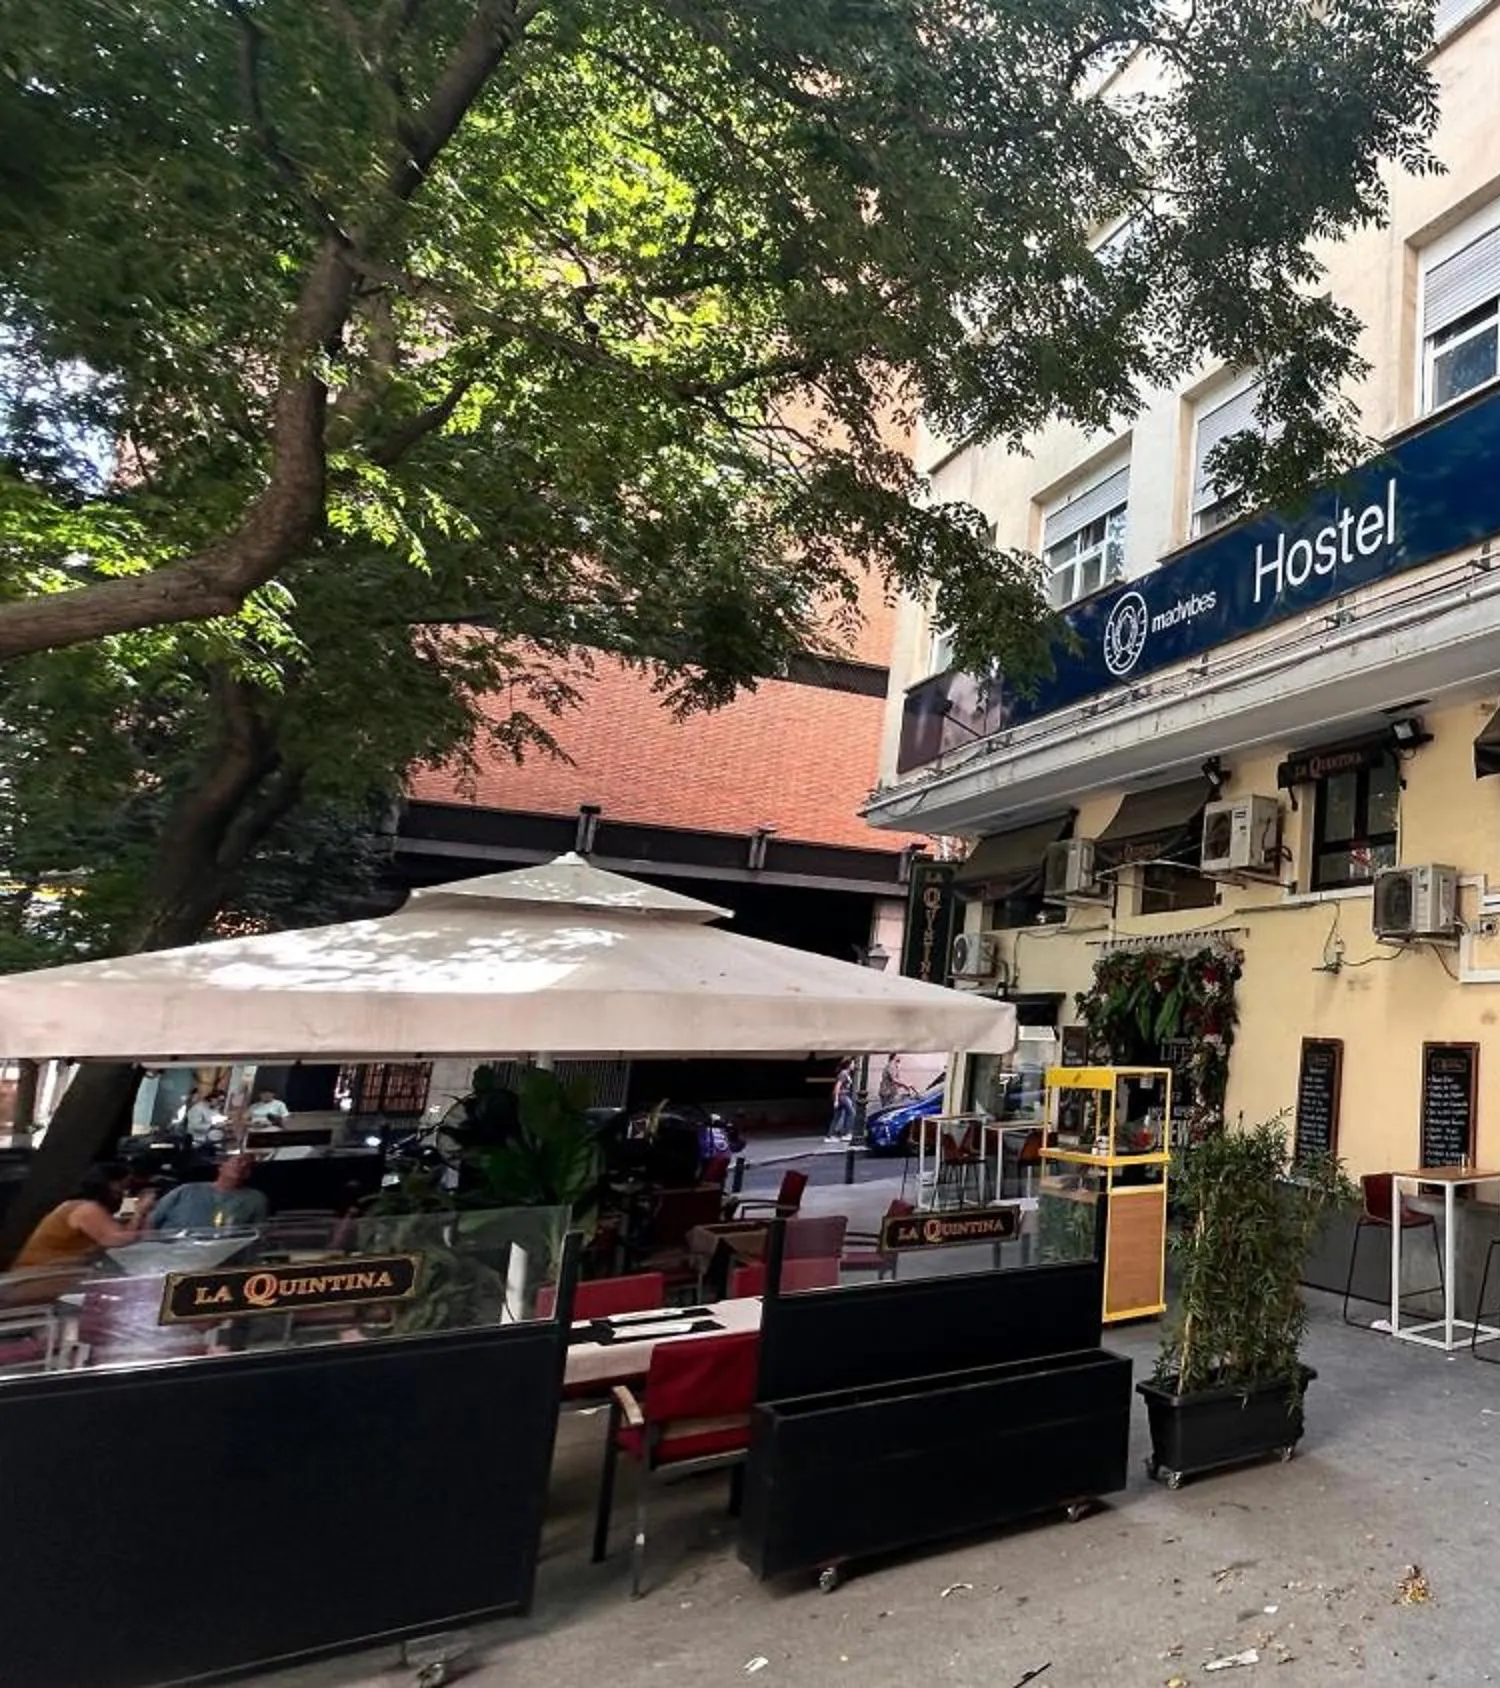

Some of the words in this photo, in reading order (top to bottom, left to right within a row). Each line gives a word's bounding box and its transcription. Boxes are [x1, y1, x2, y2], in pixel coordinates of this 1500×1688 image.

[1253, 477, 1397, 603] Hostel
[1151, 589, 1217, 633] madvibes
[897, 1227, 919, 1241] LA
[923, 1219, 1004, 1243] QUINTINA
[194, 1285, 234, 1305] LA
[243, 1271, 394, 1307] QUINTINA
